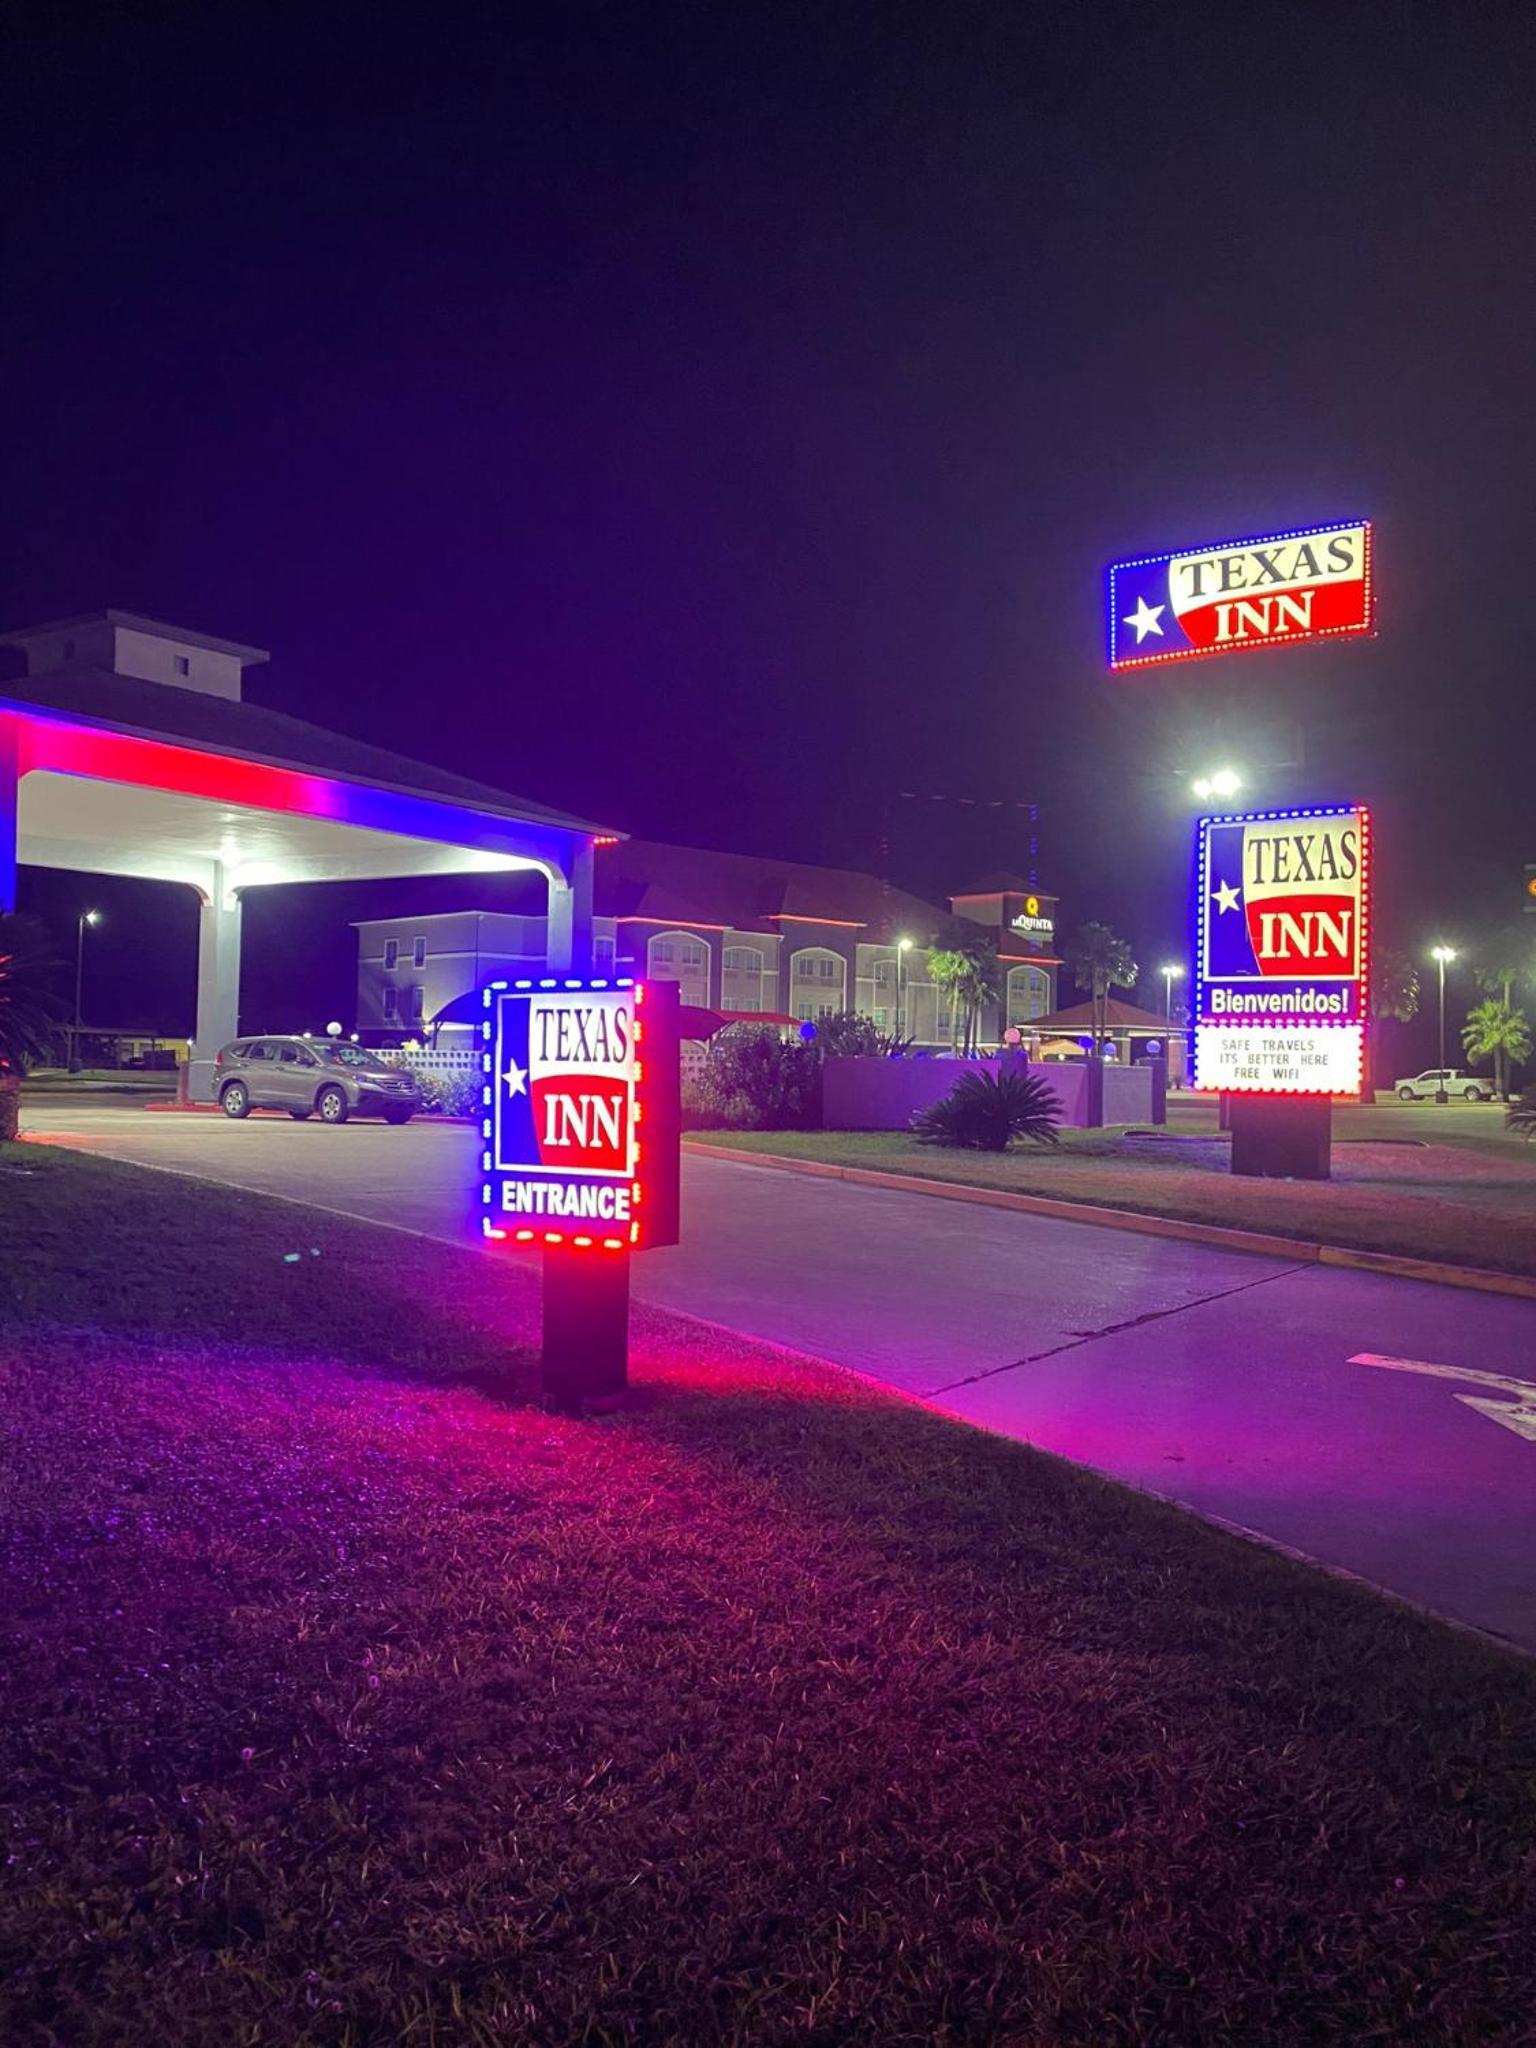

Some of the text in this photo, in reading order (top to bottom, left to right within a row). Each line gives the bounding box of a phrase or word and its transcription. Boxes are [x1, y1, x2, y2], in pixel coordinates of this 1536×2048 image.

[1180, 535, 1354, 598] TEXAS
[1214, 590, 1315, 642] INN
[1248, 830, 1357, 884] TEXAS
[1259, 911, 1352, 959] INN
[1211, 988, 1348, 1013] Bienvenidos!
[536, 1007, 628, 1063] TEXAS
[1222, 1039, 1315, 1051] SAFE TRAVELS
[1220, 1053, 1328, 1066] ITS BETTER HERE
[1234, 1067, 1299, 1080] FREE WIFI
[543, 1094, 623, 1150] INN
[501, 1180, 631, 1221] ENTRANCE
